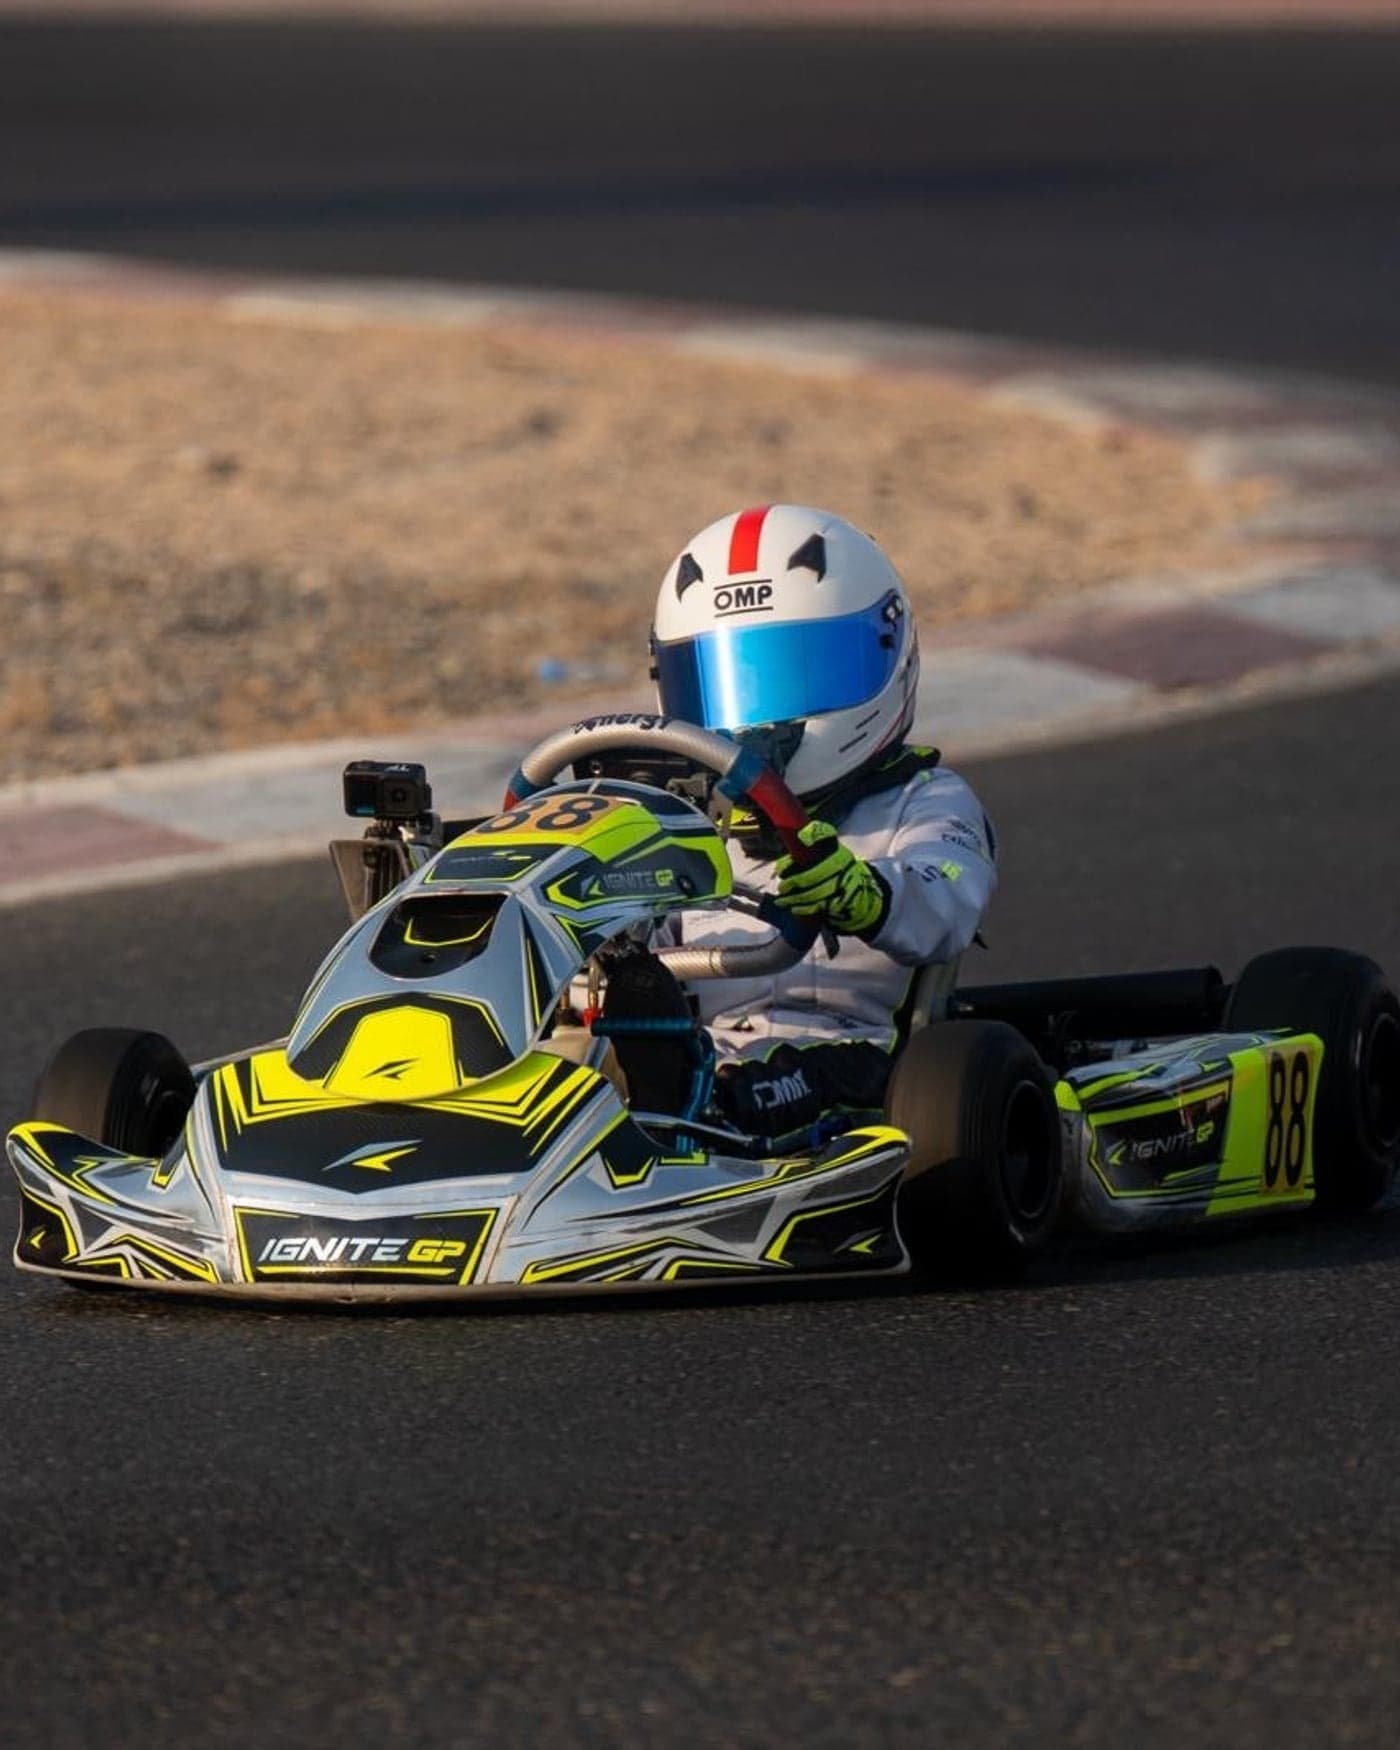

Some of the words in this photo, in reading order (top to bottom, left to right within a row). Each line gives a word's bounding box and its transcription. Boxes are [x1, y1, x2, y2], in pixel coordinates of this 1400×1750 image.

[714, 585, 773, 611] OMP
[476, 797, 609, 833] 88
[1264, 1050, 1310, 1189] 88
[258, 1237, 409, 1262] IGNITE
[407, 1239, 466, 1263] GP
